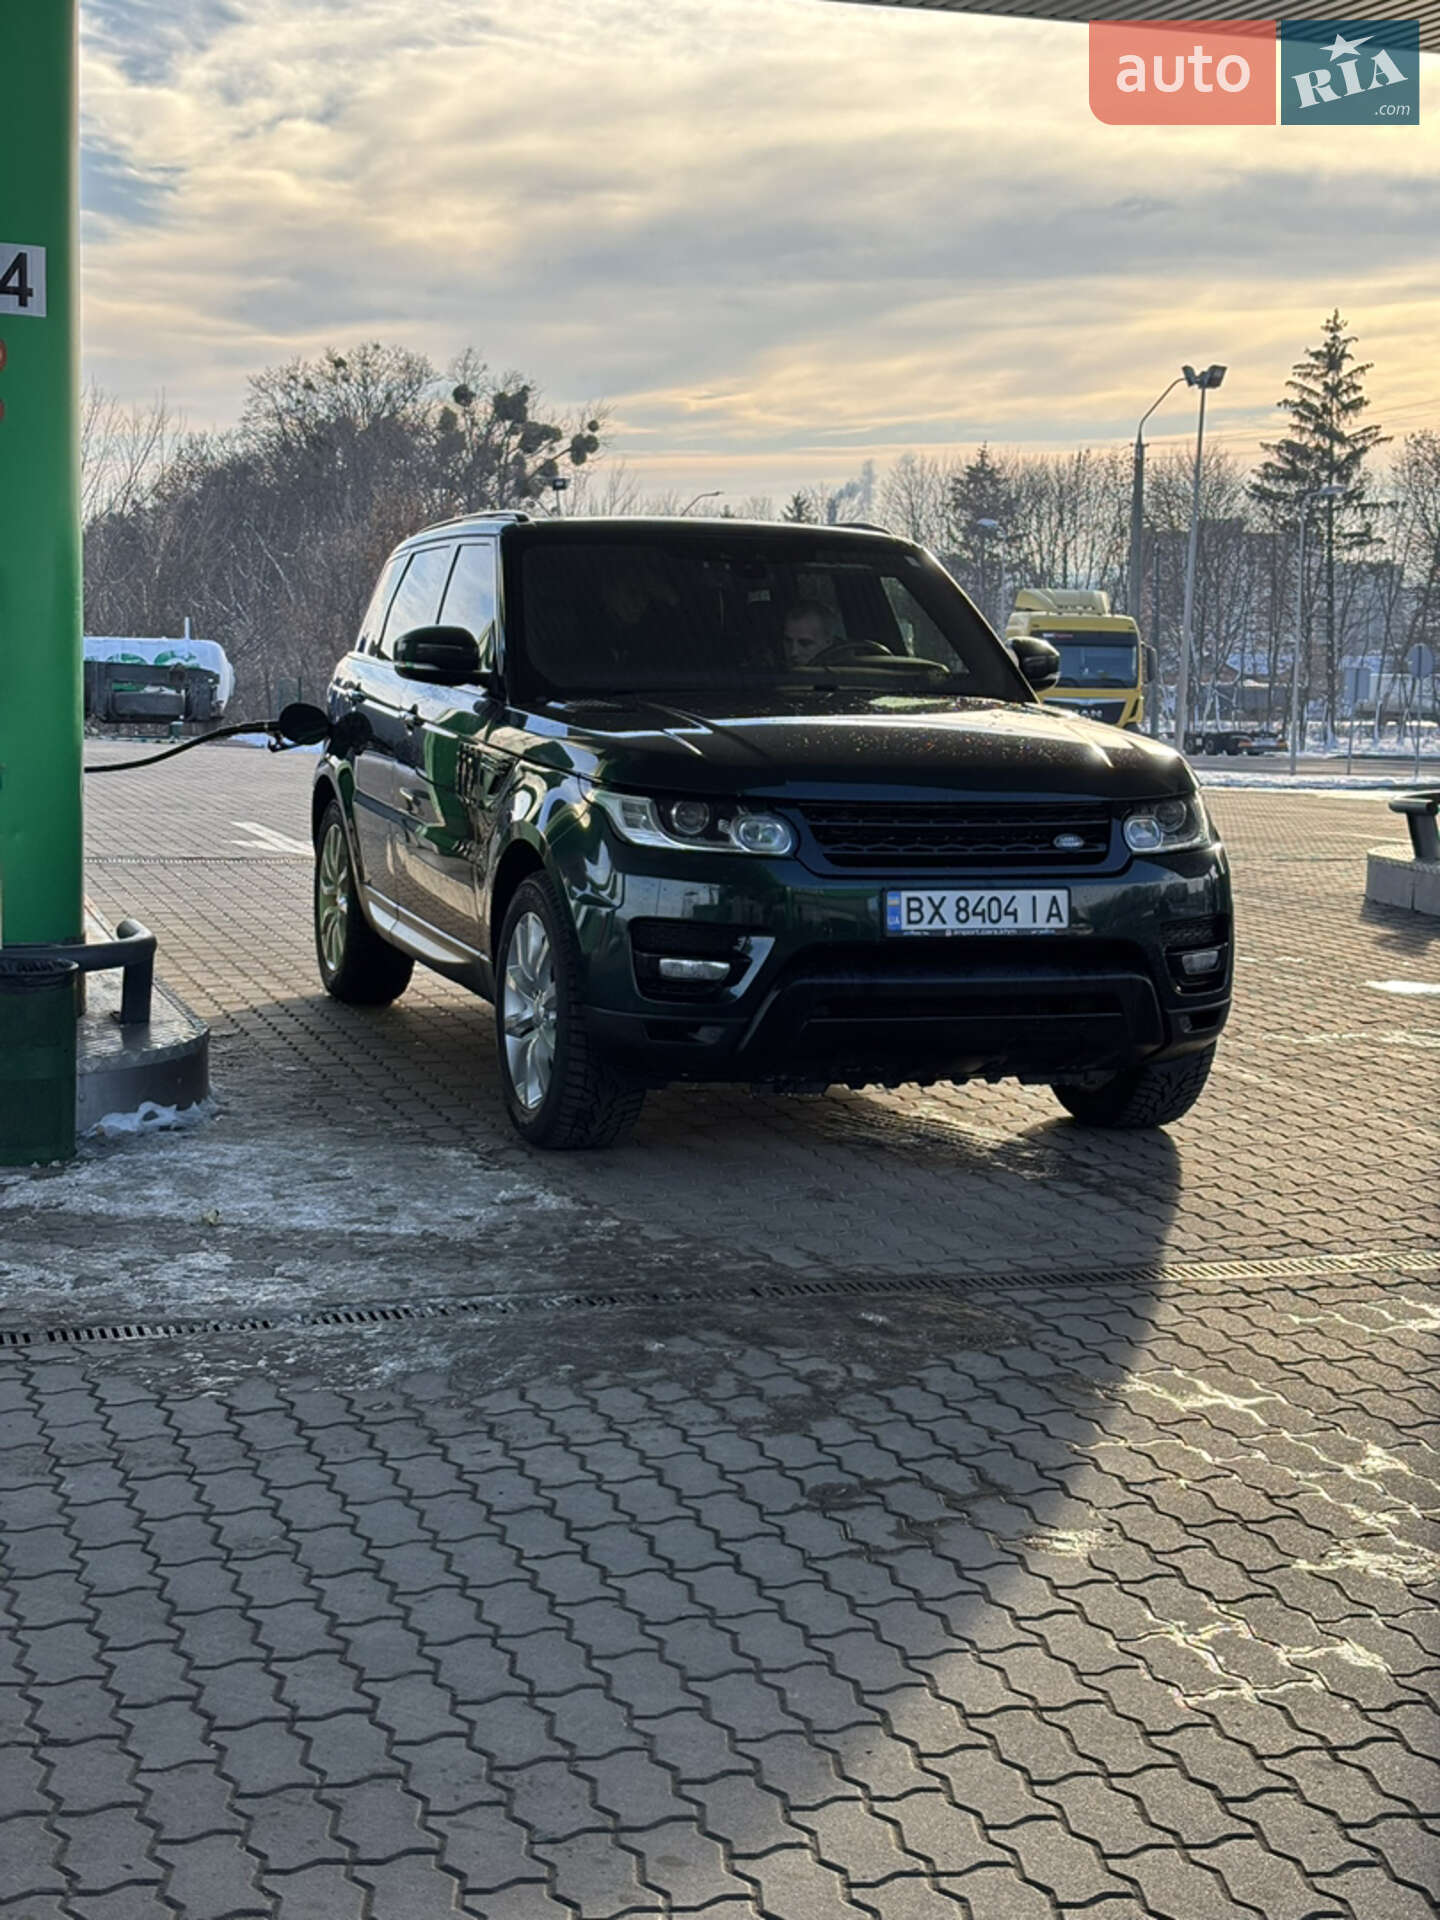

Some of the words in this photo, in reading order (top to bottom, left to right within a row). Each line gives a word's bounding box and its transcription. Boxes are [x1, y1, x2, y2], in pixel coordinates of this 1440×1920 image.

[0, 252, 34, 308] 4
[906, 896, 947, 925] BX
[955, 896, 1018, 924] 8404
[1032, 895, 1064, 923] IA
